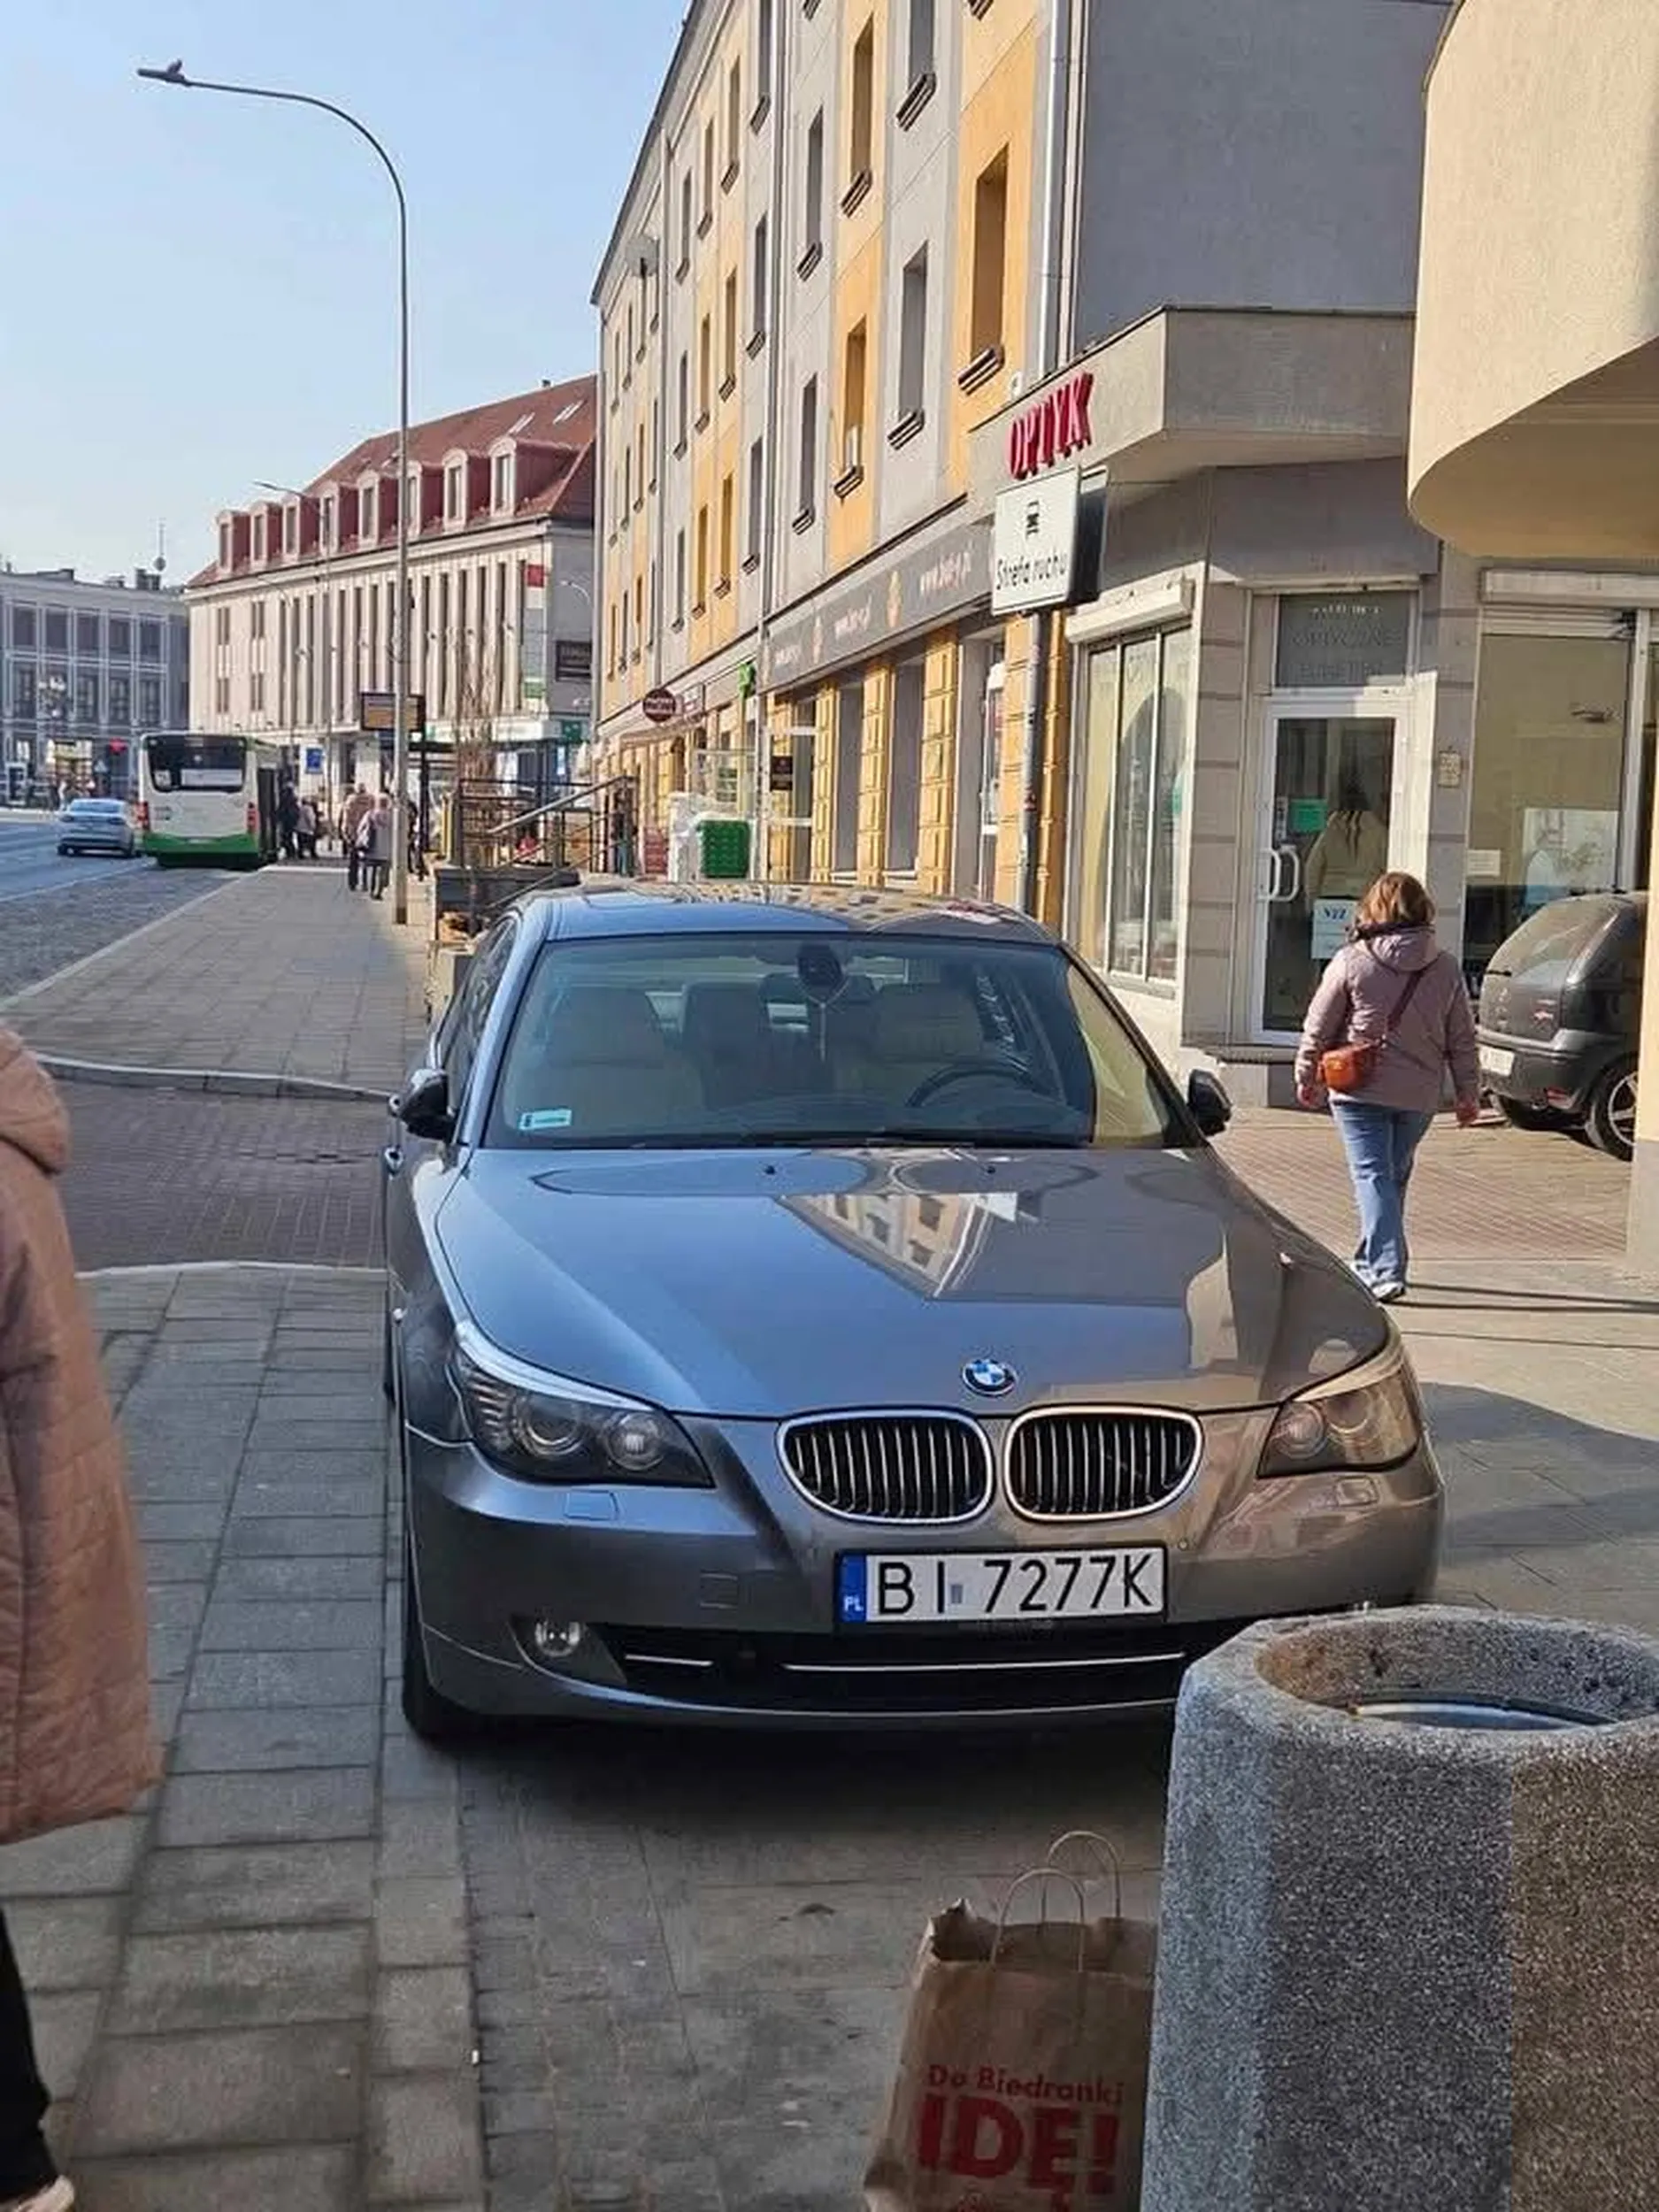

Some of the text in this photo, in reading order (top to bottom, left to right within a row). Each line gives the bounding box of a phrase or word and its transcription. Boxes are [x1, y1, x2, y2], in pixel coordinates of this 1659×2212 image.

[1007, 371, 1094, 480] OPTYK
[844, 1595, 864, 1611] PL
[983, 1553, 1154, 1614] 7277K
[929, 2064, 1125, 2104] Do Biedronki
